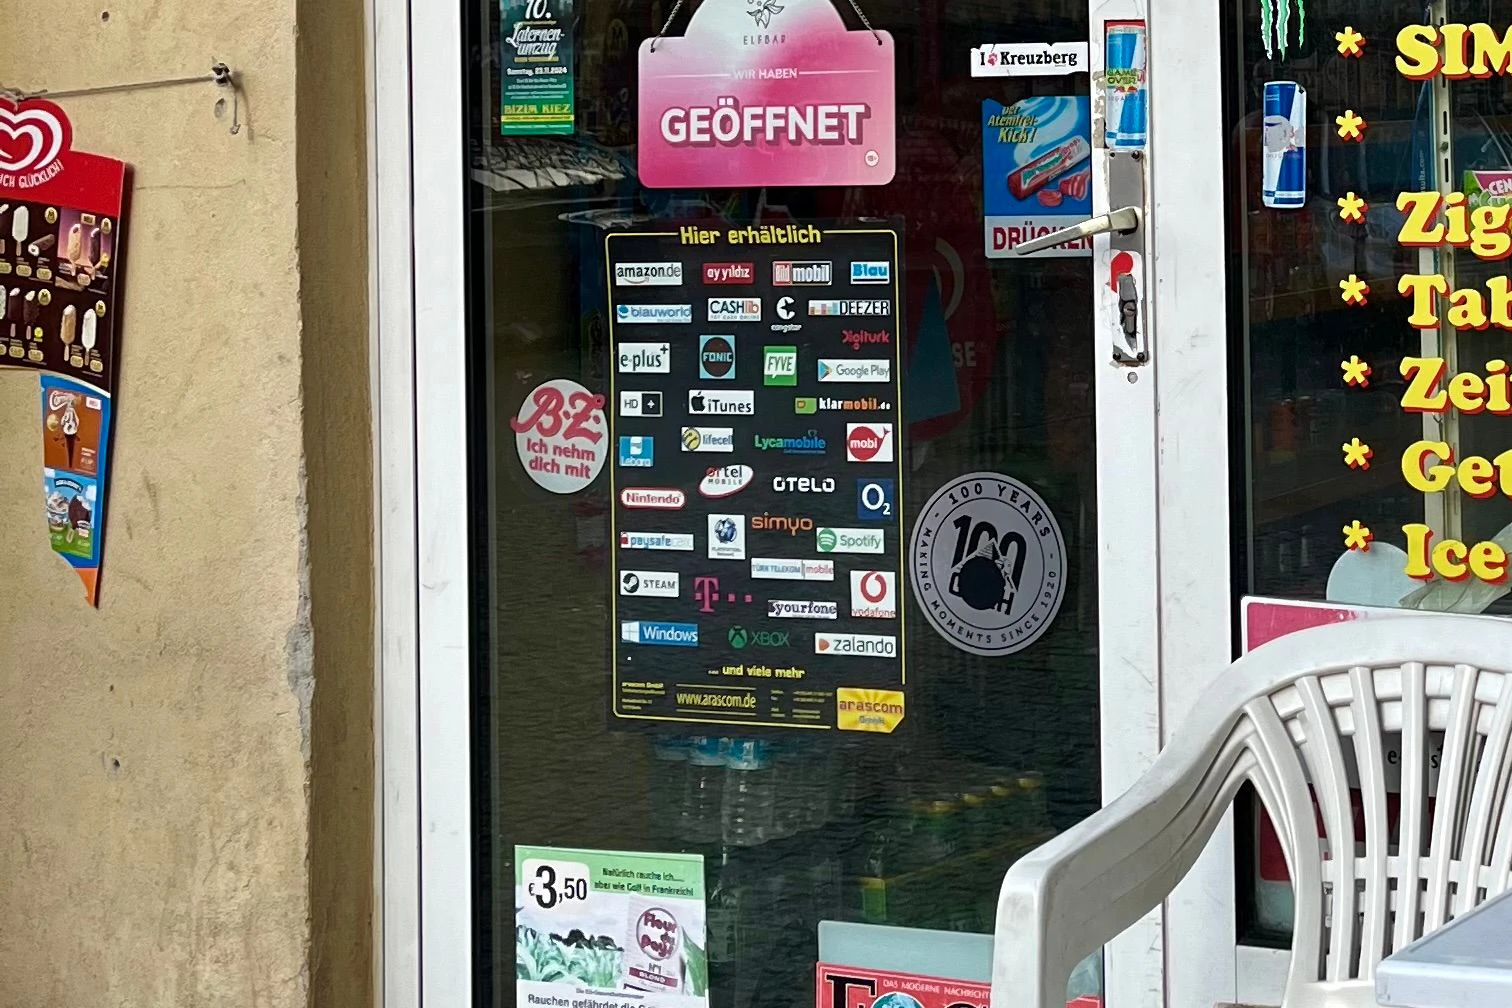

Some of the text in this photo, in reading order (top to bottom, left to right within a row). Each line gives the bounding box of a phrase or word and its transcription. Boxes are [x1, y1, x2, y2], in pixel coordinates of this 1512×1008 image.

[505, 21, 565, 48] Laternen-
[517, 42, 557, 61] umzug
[1000, 52, 1077, 66] Kreuzberg
[758, 68, 797, 79] HABEN
[660, 96, 871, 147] GEÖFFNET
[998, 128, 1037, 143] Kick!
[680, 225, 822, 245] Hier erhältlich
[616, 264, 682, 281] amazon.de
[792, 265, 830, 283] mobil
[852, 264, 888, 277] Blau
[631, 307, 690, 318] blauworld
[840, 301, 890, 314] DEEZER
[702, 351, 733, 363] FONIC
[768, 355, 793, 374] FYVE
[836, 364, 890, 379] Google Play
[707, 398, 752, 413] iTunes
[819, 397, 891, 410] klarmobil.de
[702, 433, 733, 446] lifecell
[754, 433, 826, 449] Lycamobile
[850, 438, 878, 450] mobi
[526, 438, 596, 461] Ich nehm
[529, 456, 592, 479] dich mit
[707, 477, 743, 486] MOBILE
[626, 492, 681, 505] Nintendo
[949, 483, 1051, 538] 100 YEARS
[751, 513, 813, 536] simyo
[839, 534, 882, 549] Spotify
[1401, 523, 1508, 582] Ice
[805, 564, 834, 575] mobile
[643, 579, 676, 590] STEAM
[919, 526, 933, 592] MAKING
[931, 599, 992, 644] MOMENTS
[1001, 613, 1040, 643] SINCE
[773, 602, 837, 616] yourfone
[851, 607, 896, 618] vodafone
[643, 627, 698, 643] Windows
[751, 632, 791, 647] XBOX
[833, 637, 894, 656] zalando
[722, 664, 806, 679] und viele mehr
[676, 693, 757, 709] www.arascom.de
[839, 699, 903, 714] arascom
[535, 865, 587, 909] 3,50
[883, 979, 899, 988] DAS
[901, 981, 940, 994] MODERNE
[528, 994, 570, 1008] Rauchen
